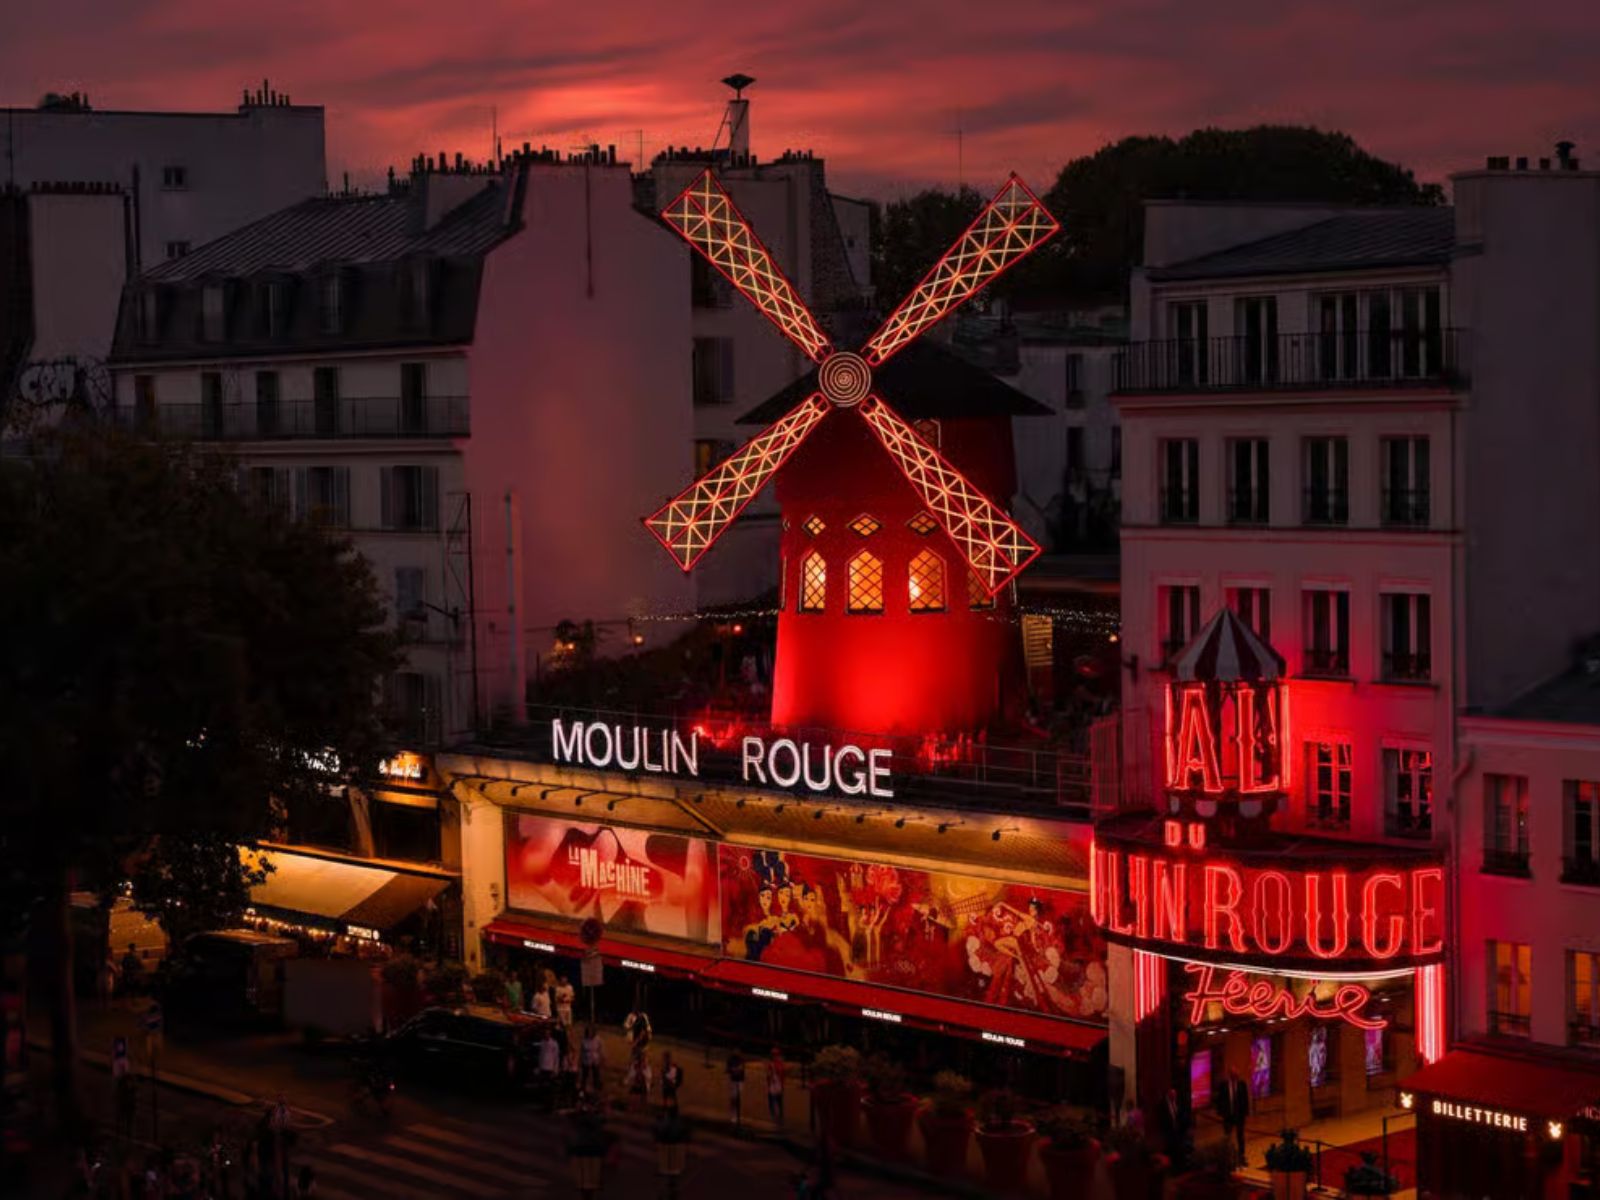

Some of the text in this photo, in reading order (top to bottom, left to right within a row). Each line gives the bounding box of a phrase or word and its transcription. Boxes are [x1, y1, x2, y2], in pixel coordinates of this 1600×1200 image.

[552, 719, 894, 797] MOULIN ROUGE
[1164, 819, 1206, 850] DU
[1203, 863, 1444, 960] ROUGE
[1184, 962, 1388, 1029] Féerie
[1432, 1099, 1528, 1132] BILLETTERIE
